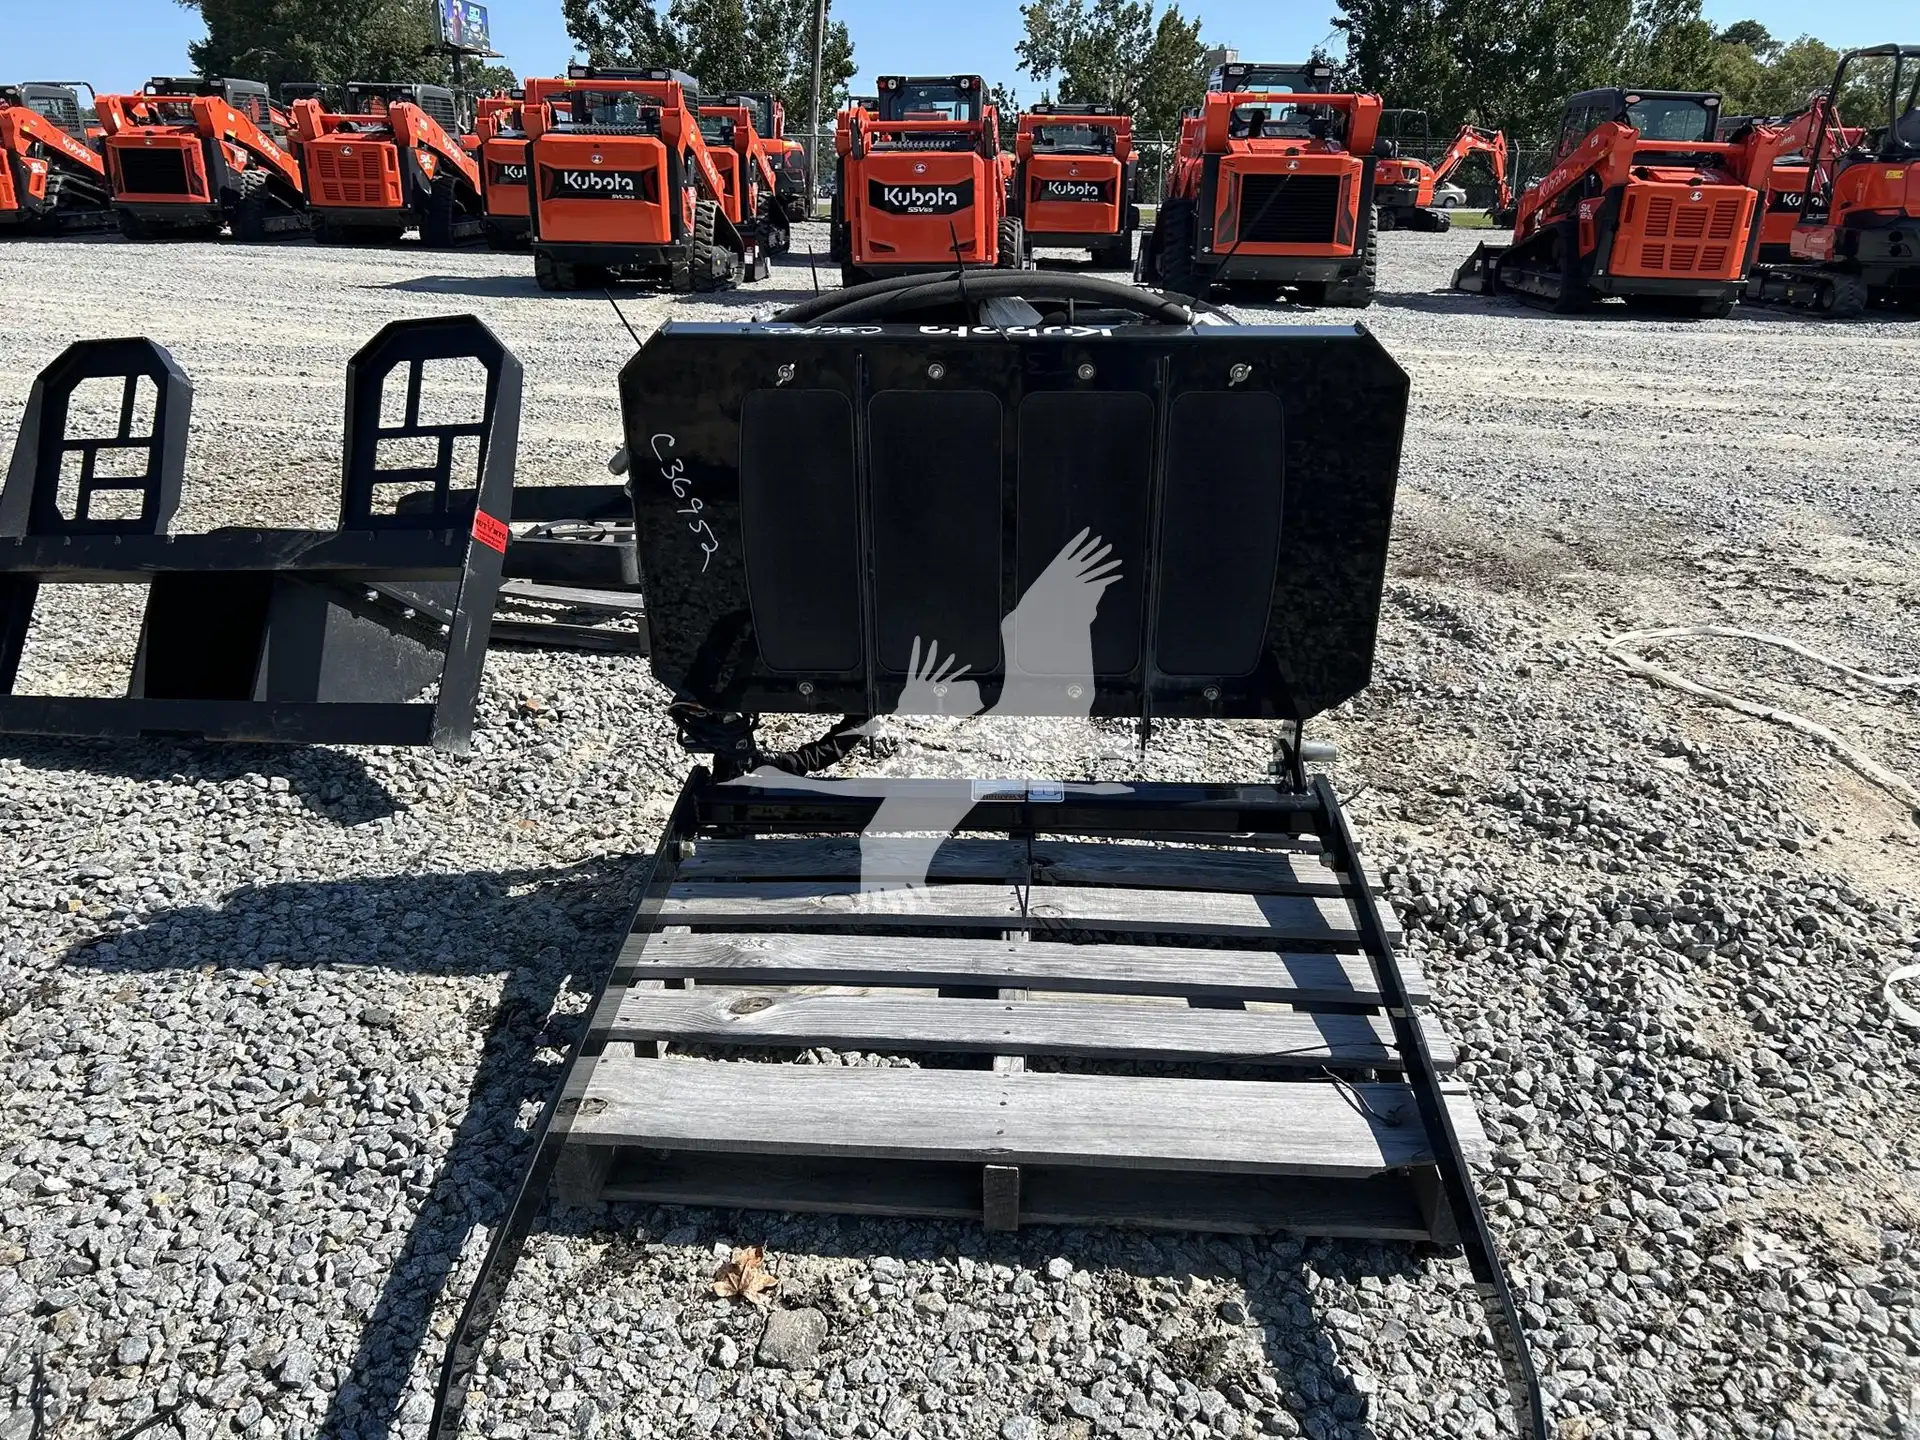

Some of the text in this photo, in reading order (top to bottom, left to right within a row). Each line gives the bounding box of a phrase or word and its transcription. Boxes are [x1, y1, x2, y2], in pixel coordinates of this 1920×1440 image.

[563, 171, 634, 191] Kubota
[1048, 181, 1098, 196] Kubota
[1540, 168, 1568, 197] Kubota
[884, 187, 958, 206] Kubota
[920, 325, 1112, 338] Kubota
[651, 433, 719, 573] C36952
